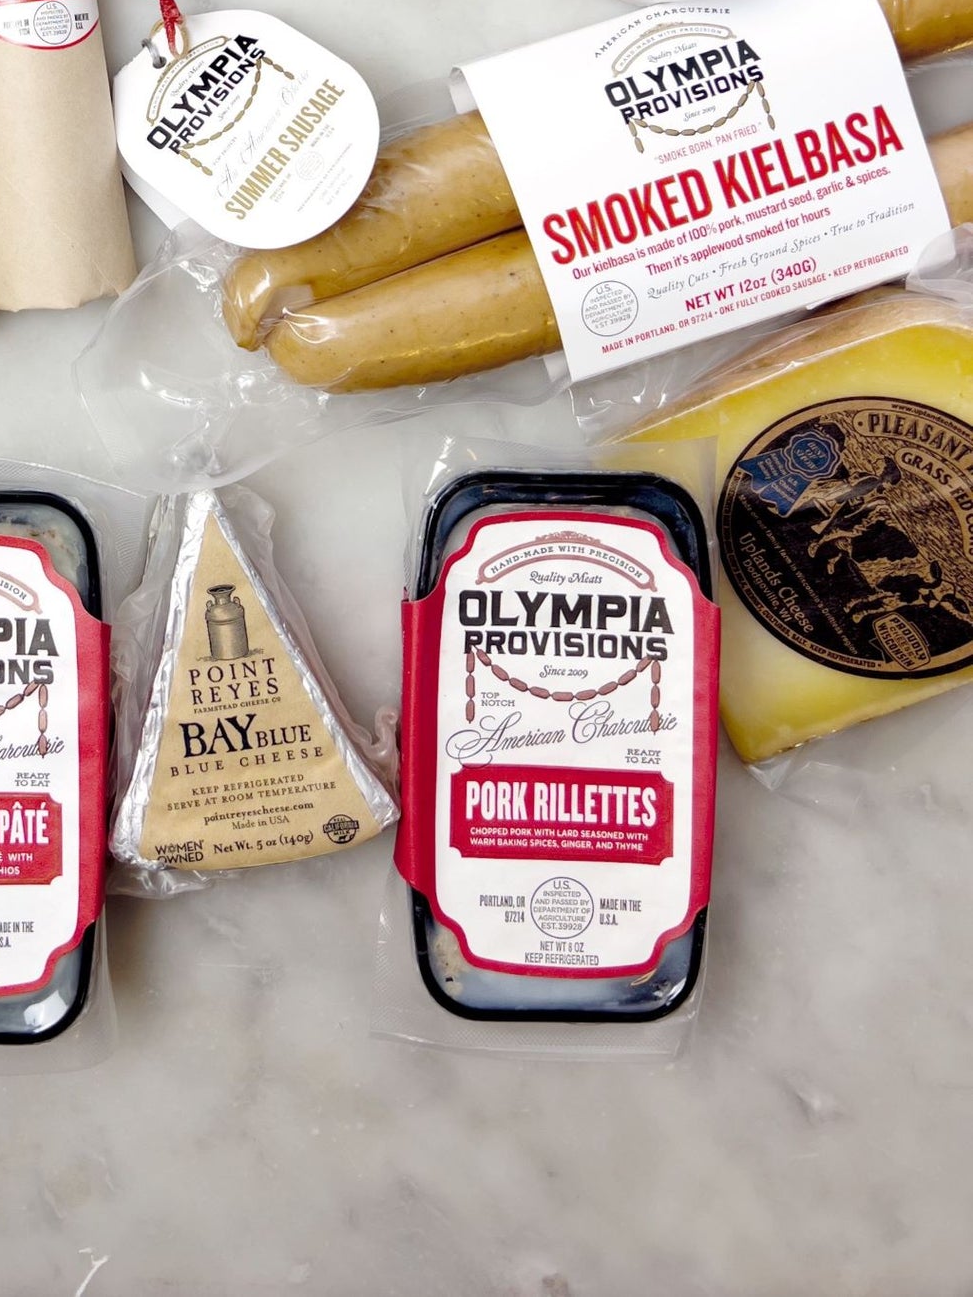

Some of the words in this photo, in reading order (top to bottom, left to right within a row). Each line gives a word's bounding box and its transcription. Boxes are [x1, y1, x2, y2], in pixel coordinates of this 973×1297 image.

[594, 19, 642, 58] AMERICAN
[646, 8, 731, 21] CHARCUTERIE
[147, 34, 259, 150] OLYMPIA
[604, 39, 761, 107] OLYMPIA
[619, 65, 764, 125] PROVISIONS
[168, 48, 266, 155] PROVISIONS
[225, 147, 291, 220] SUMMER
[278, 79, 346, 152] SAUSAGE
[542, 167, 714, 266] SMOKED
[713, 104, 905, 210] KIELBASA
[572, 267, 592, 280] Our
[593, 253, 636, 274] kielbasa
[636, 248, 646, 258] is
[647, 238, 675, 256] made
[677, 233, 688, 246] of
[688, 223, 718, 240] 100%
[718, 216, 745, 233] pork,
[745, 199, 788, 223] mustard
[788, 190, 815, 207] seed,
[816, 182, 845, 201] garlic
[845, 176, 856, 188] &
[856, 166, 891, 187] spices.
[685, 293, 711, 312] NET
[714, 283, 736, 301] WT
[739, 277, 767, 294] 12oz
[770, 256, 817, 286] (340G)
[868, 412, 972, 462] PLEASANT
[459, 589, 674, 635] OLYMPIA
[464, 630, 668, 661] PROVISIONS
[189, 658, 277, 686] POINT
[191, 677, 280, 705] REYES
[539, 665, 566, 679] Since
[567, 668, 588, 678] 2009
[179, 713, 257, 759] BAY
[255, 724, 312, 749] BLUE
[170, 760, 225, 777] BLUE
[239, 746, 324, 768] CHEESE
[203, 801, 314, 826] pointreyescheese.com
[465, 780, 528, 821] PORK
[534, 781, 657, 828] RILLETTES
[8, 853, 33, 862] WITH
[470, 827, 509, 836] CHOPPED
[509, 828, 532, 836] PORK
[534, 828, 555, 837] WITH
[557, 829, 579, 837] LARD
[580, 830, 624, 839] SEASONED
[626, 833, 648, 841] WITH
[525, 953, 544, 963] KEEP
[545, 954, 599, 966] REFRIGERATED
